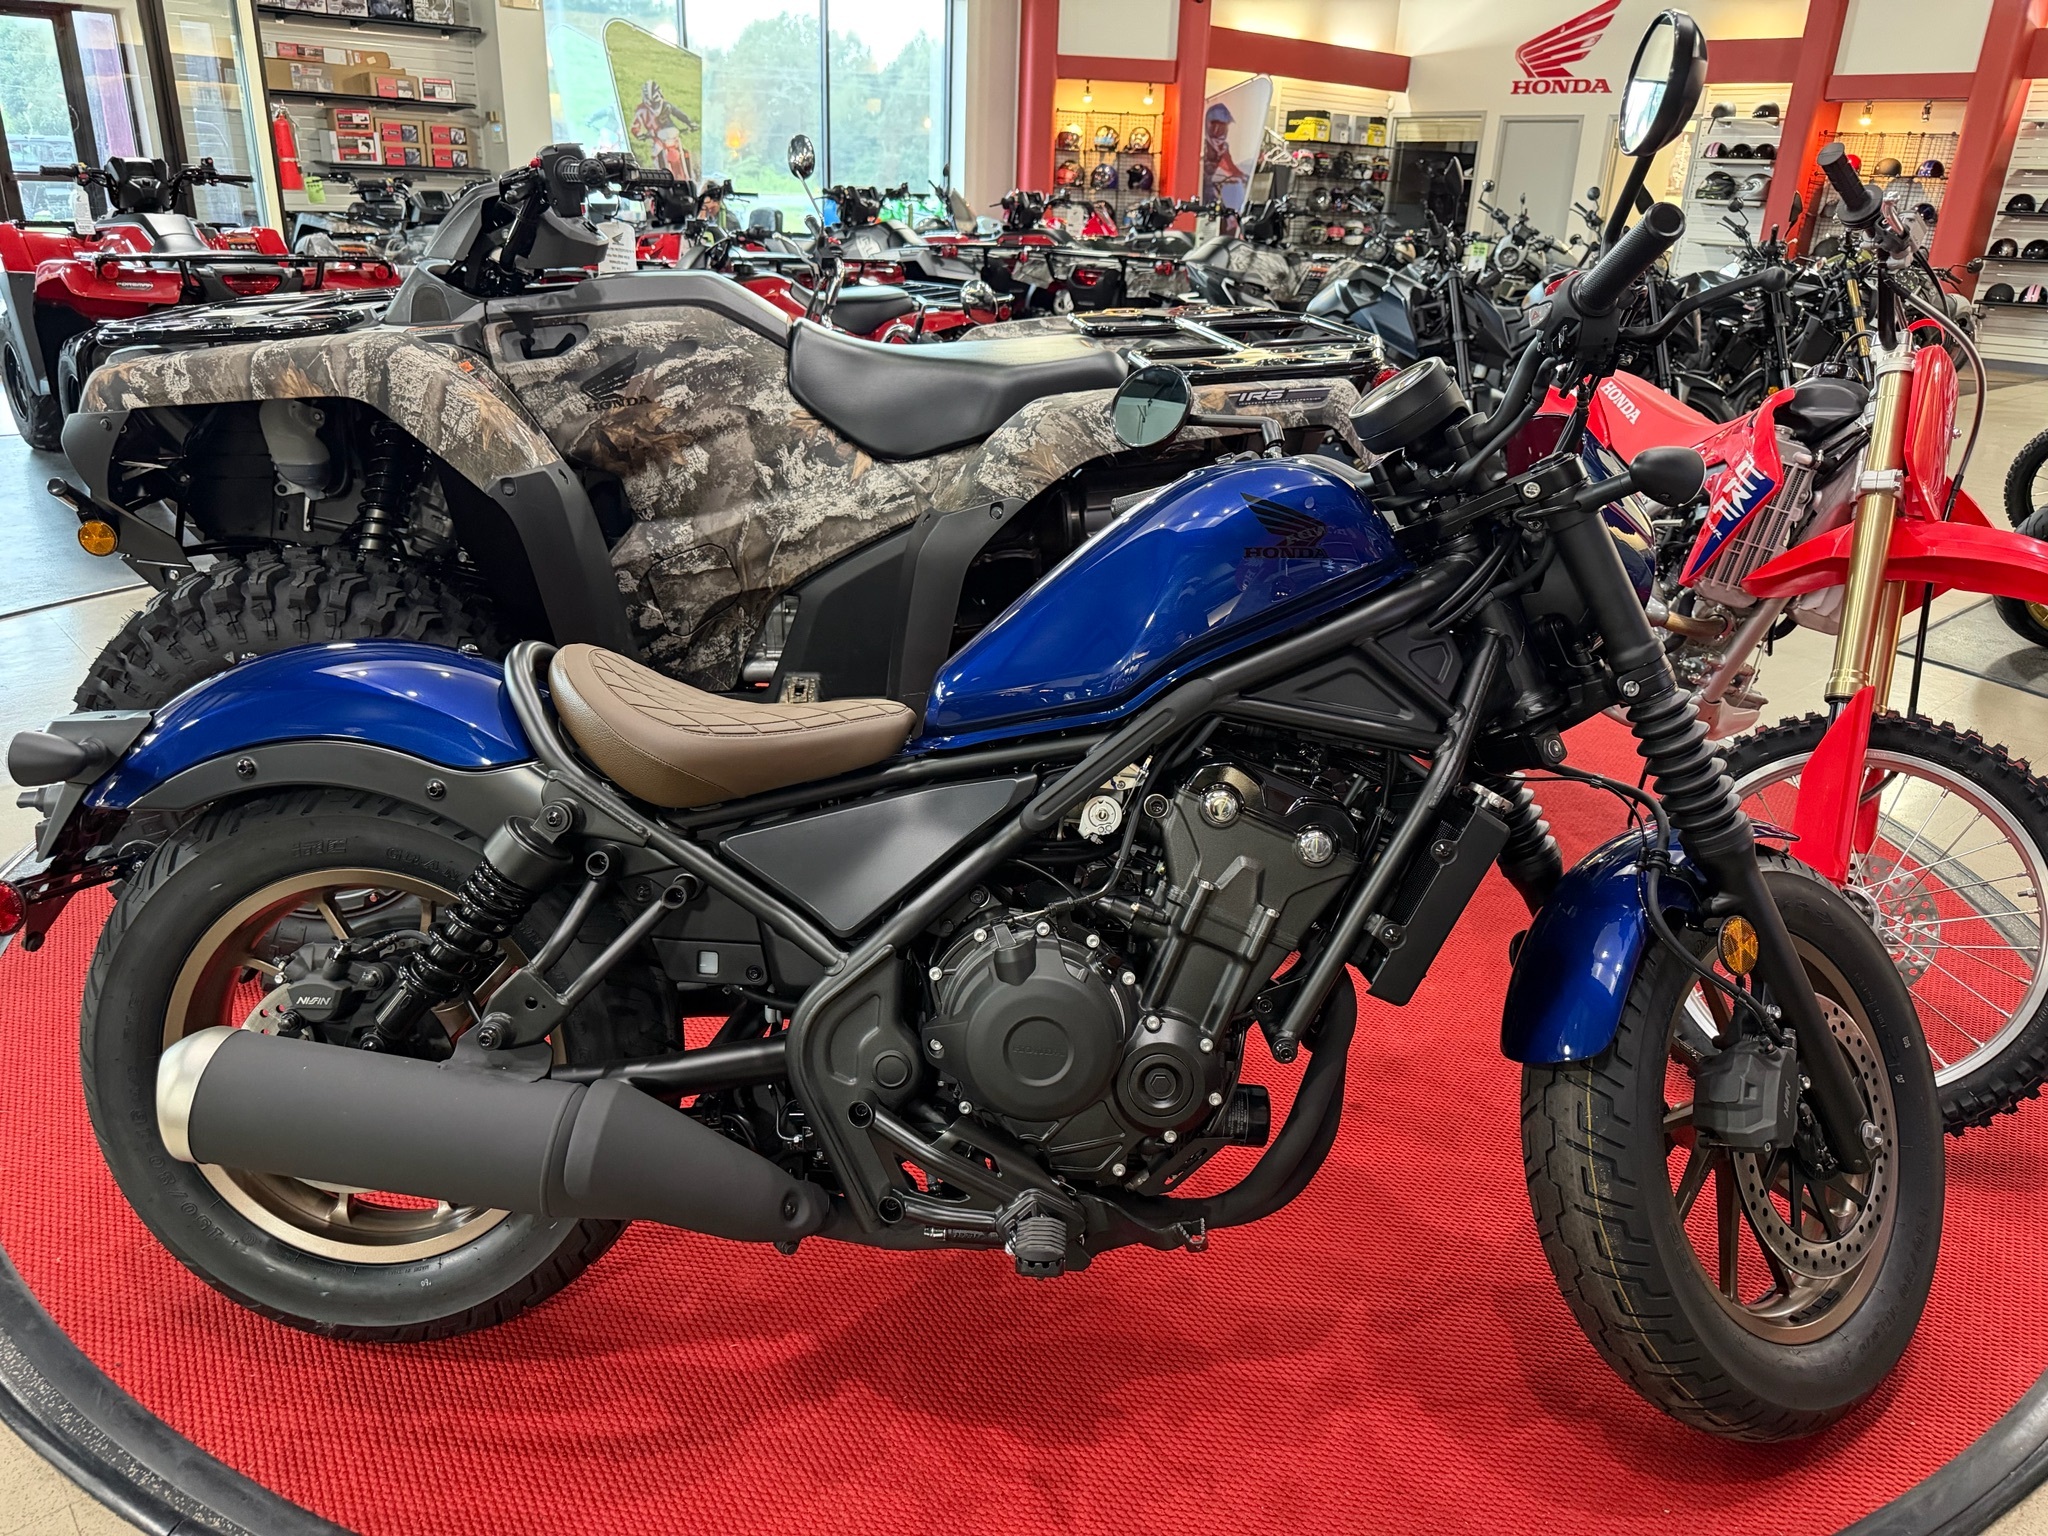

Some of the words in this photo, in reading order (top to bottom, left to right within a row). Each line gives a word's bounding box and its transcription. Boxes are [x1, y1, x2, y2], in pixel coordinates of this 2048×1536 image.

[1510, 79, 1612, 94] HONDA
[586, 395, 652, 412] HONDA
[1239, 389, 1285, 402] IRS
[1600, 380, 1641, 425] HONDA
[1243, 547, 1329, 559] HONDA
[294, 838, 348, 857] IRC
